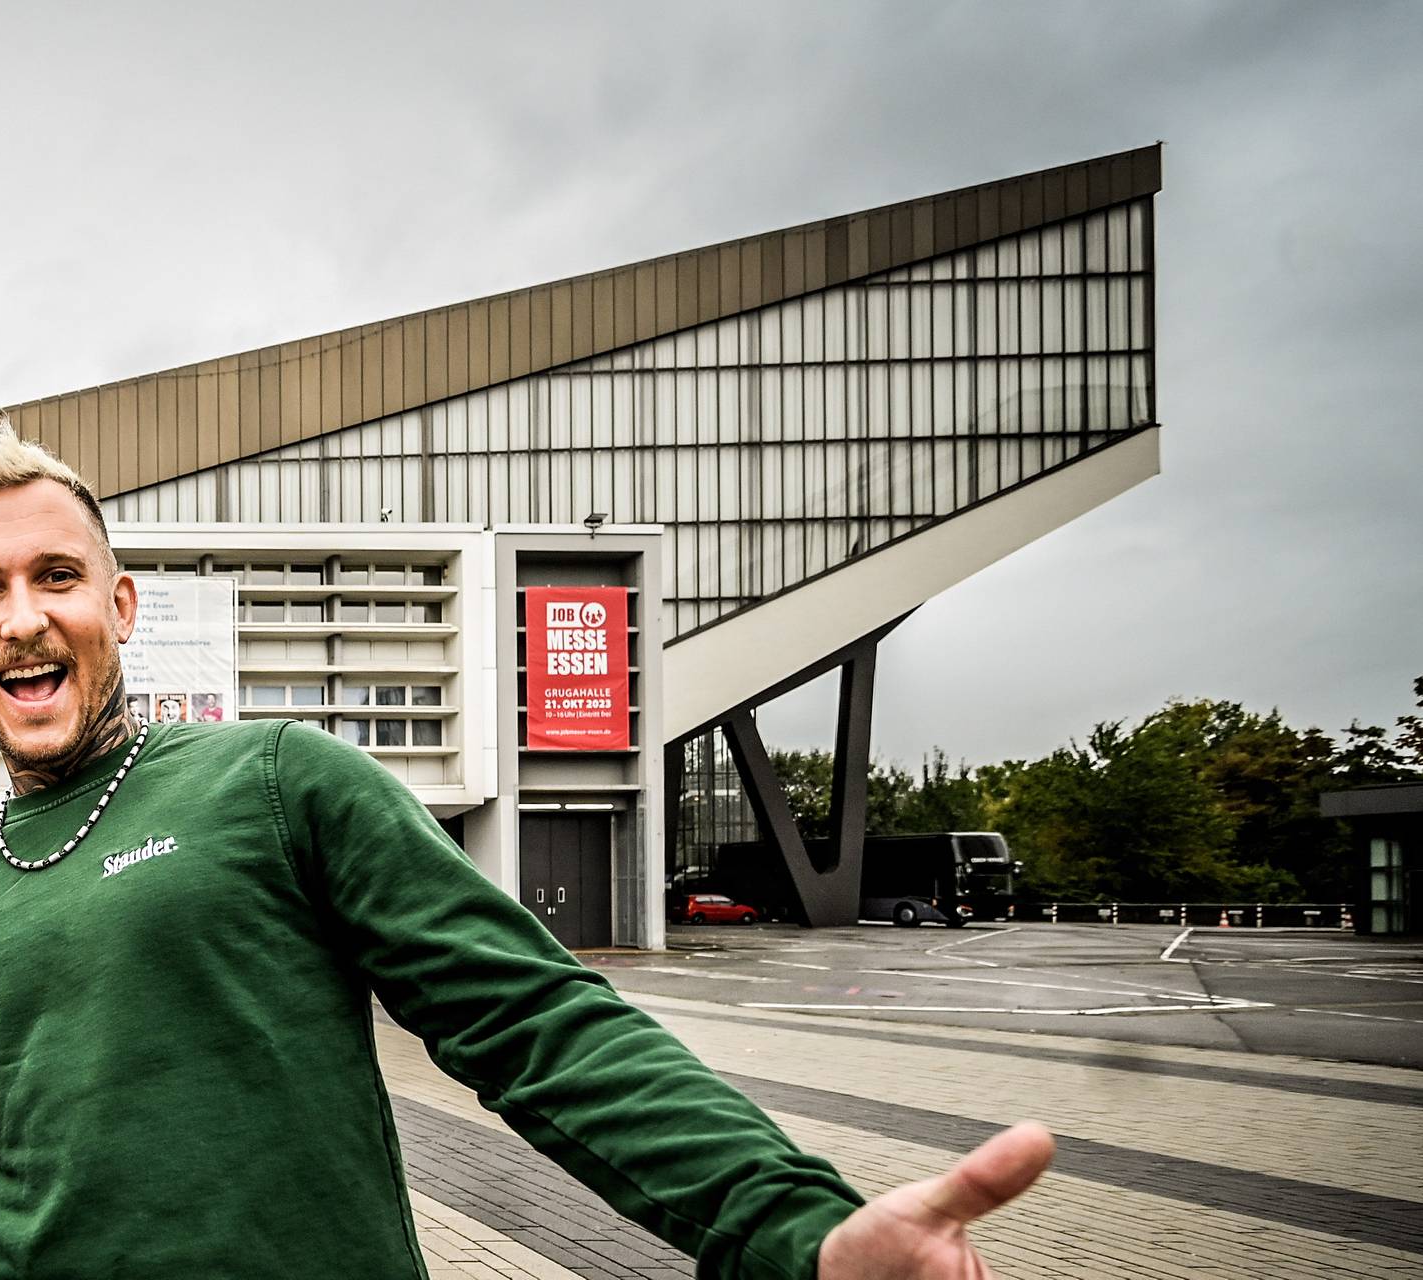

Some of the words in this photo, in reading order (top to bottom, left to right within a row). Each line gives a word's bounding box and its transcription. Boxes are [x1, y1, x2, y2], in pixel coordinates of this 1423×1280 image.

[552, 608, 575, 622] JOB
[546, 629, 607, 651] MESSE
[547, 652, 608, 675] ESSEN
[545, 688, 611, 698] GRUGAHALLE
[545, 700, 561, 709] 21.
[563, 700, 585, 709] OKT
[586, 700, 612, 709] 2023
